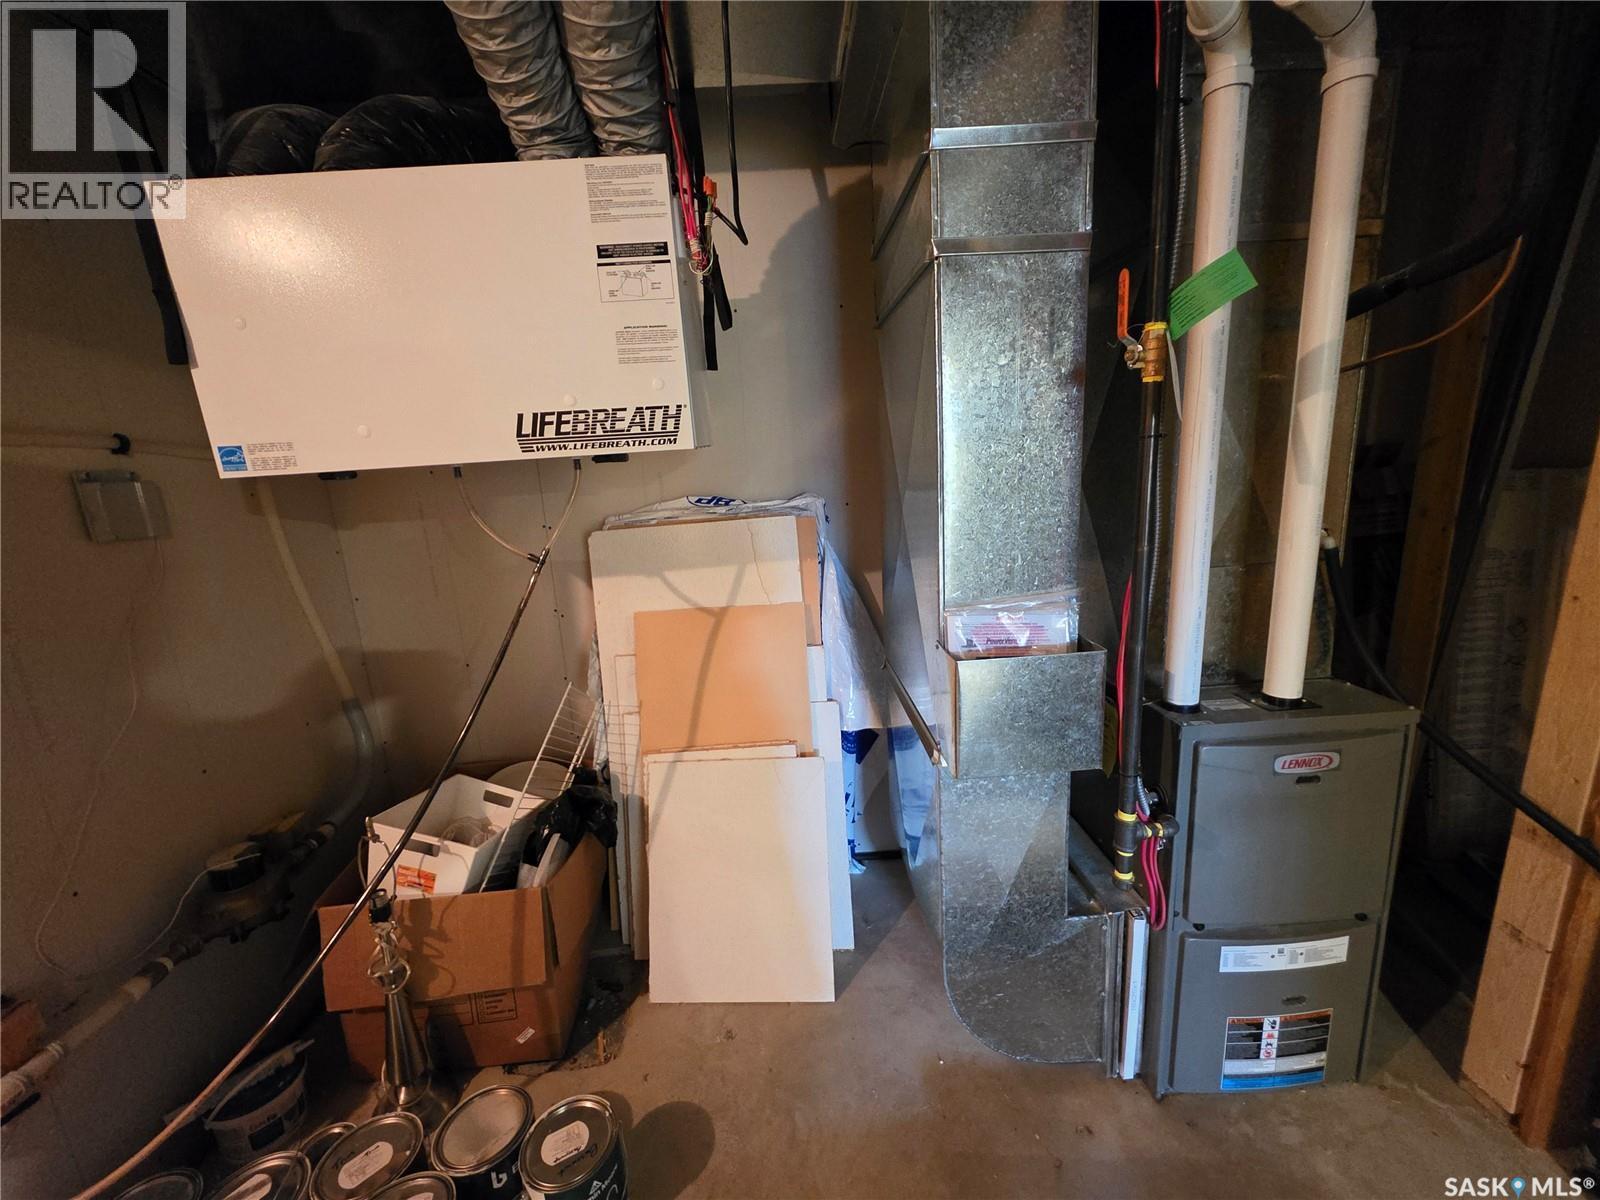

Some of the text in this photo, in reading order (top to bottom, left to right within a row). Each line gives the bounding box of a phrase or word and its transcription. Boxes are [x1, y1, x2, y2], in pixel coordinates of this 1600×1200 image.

[516, 404, 683, 438] LIFEBREATH
[535, 438, 678, 452] WWW.LIFEBREATH.COM
[1281, 757, 1324, 769] LENNOX
